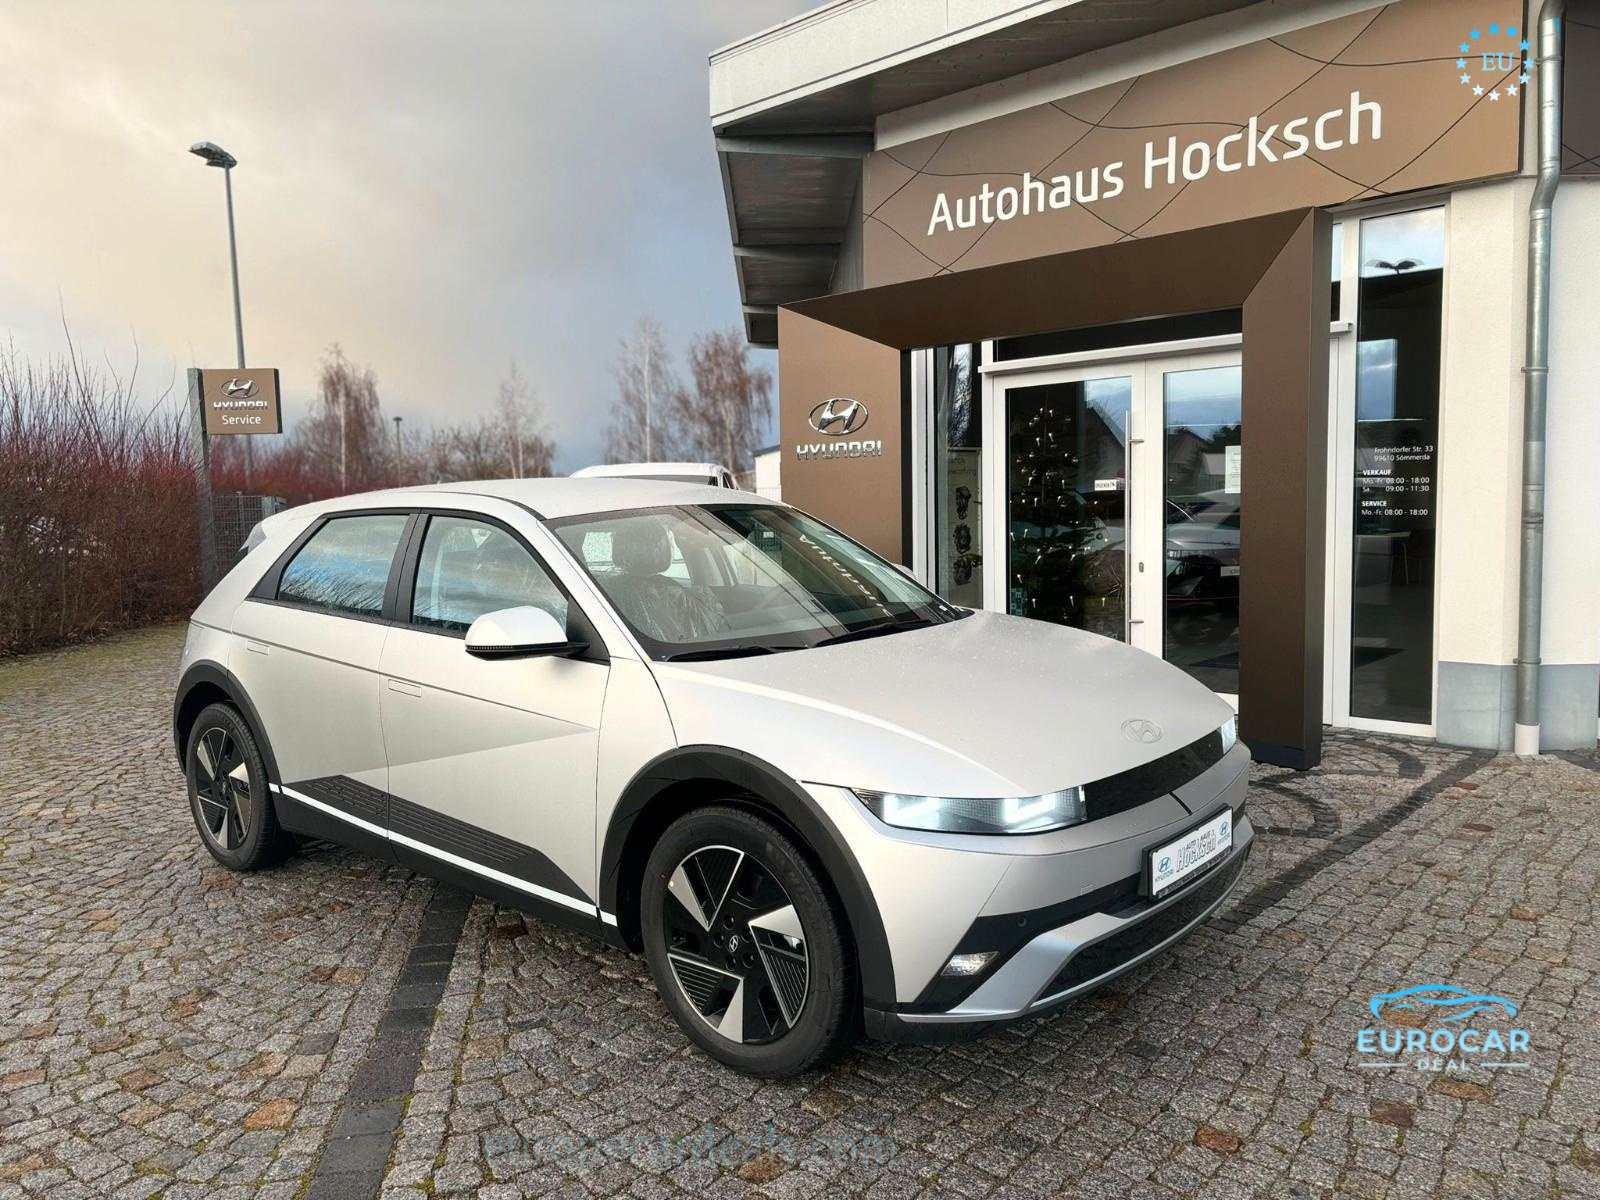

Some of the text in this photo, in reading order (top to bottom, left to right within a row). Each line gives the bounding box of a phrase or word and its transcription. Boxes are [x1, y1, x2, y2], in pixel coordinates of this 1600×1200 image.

[927, 90, 1382, 236] Autohaus Hocksch
[222, 415, 261, 425] Service
[796, 439, 882, 461] HYUNDAI
